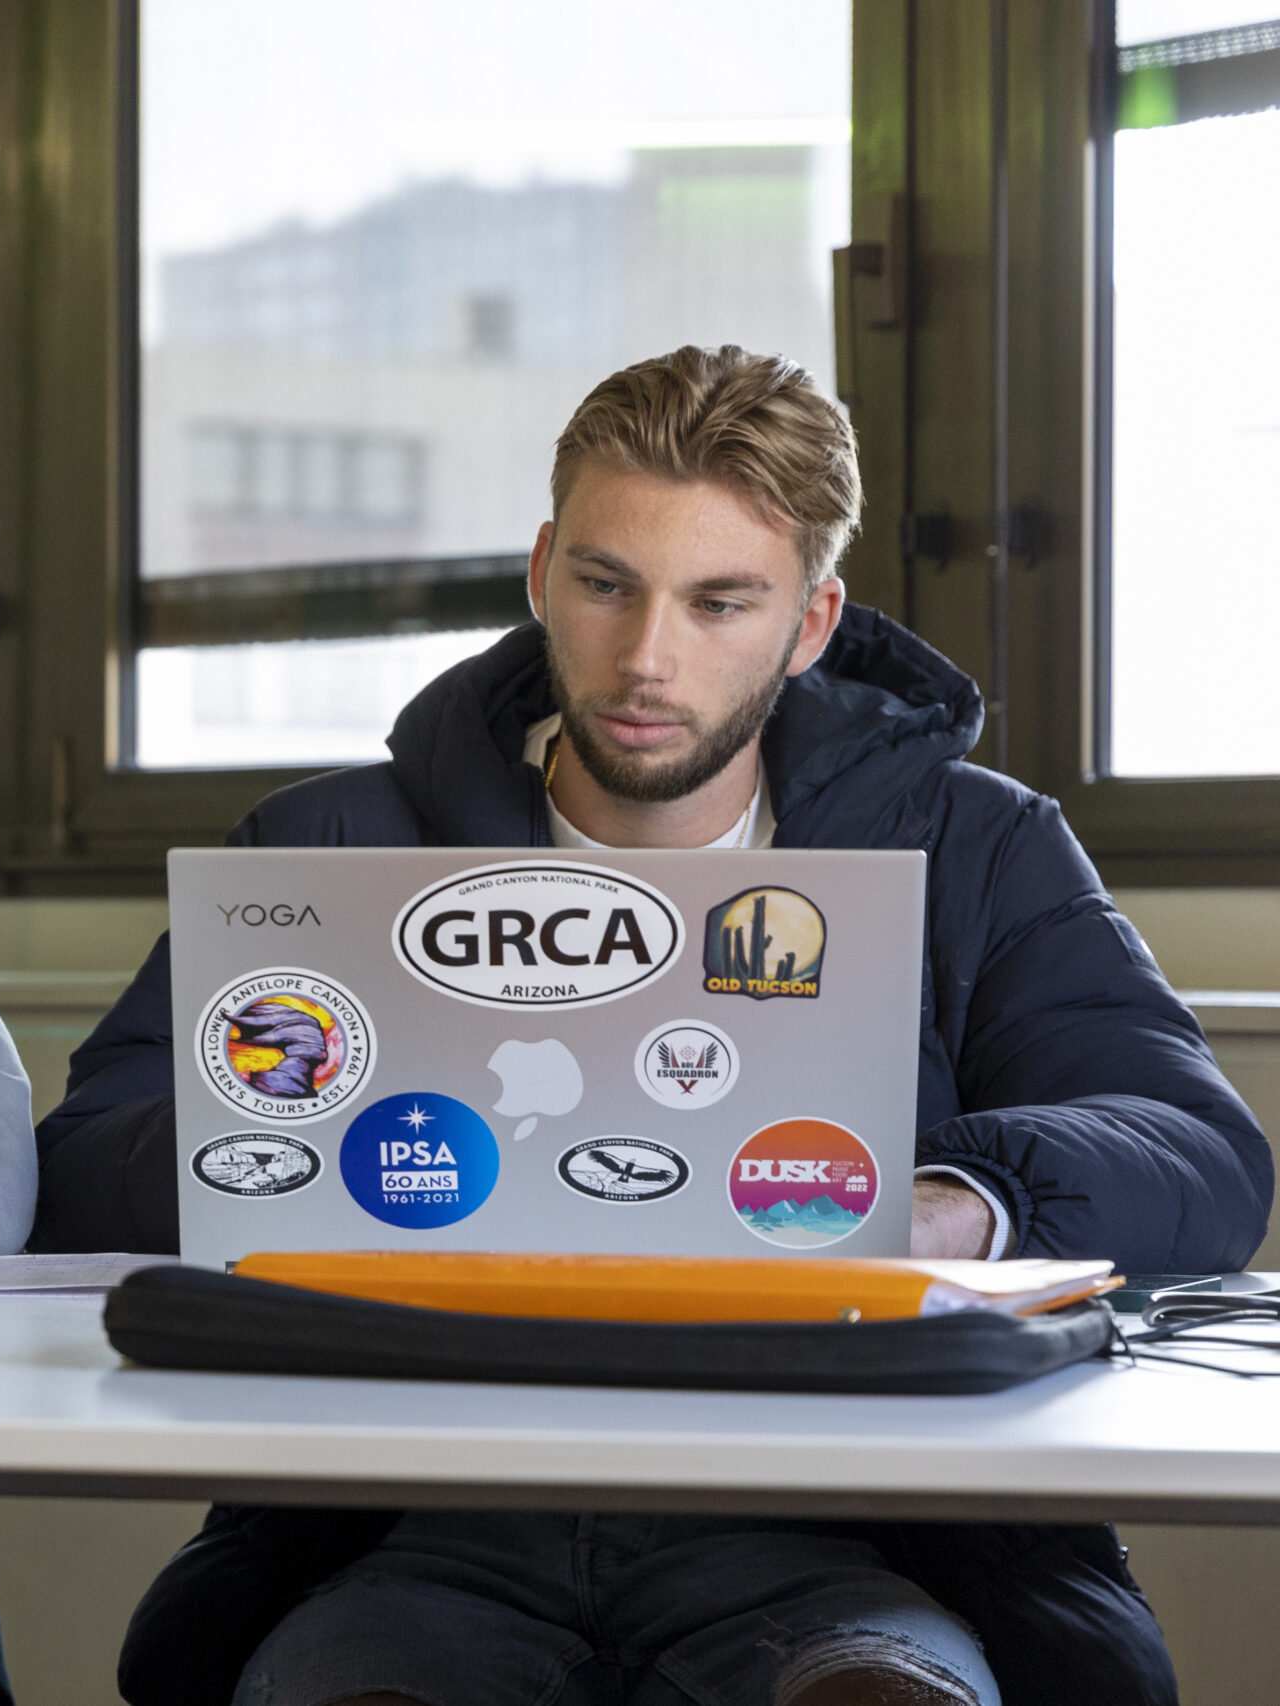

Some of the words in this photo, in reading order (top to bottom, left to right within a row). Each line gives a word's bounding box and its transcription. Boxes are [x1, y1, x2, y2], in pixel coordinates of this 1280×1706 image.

[458, 880, 494, 896] GRAND
[496, 875, 538, 886] CANYON
[541, 875, 592, 887] NATIONAL
[595, 881, 620, 895] PARK
[216, 903, 322, 927] YOGA
[421, 908, 653, 967] GRCA
[501, 984, 579, 998] ARIZONA
[707, 977, 741, 991] OLD
[747, 979, 818, 995] TUCSON
[208, 1007, 231, 1051] LOWER
[231, 978, 303, 1005] ANTELOPE
[311, 985, 360, 1032] CANYON
[321, 1084, 349, 1105] EST.
[347, 1046, 364, 1077] 1994
[657, 1069, 718, 1079] ESQUADRON
[212, 1065, 247, 1101] KEN'S
[252, 1098, 305, 1114] TOURS
[228, 1135, 255, 1144] CANYON
[256, 1134, 288, 1145] NATIONAL
[626, 1140, 659, 1151] NATIONAL
[379, 1141, 458, 1167] IPSA
[738, 1158, 831, 1184] DUSK
[385, 1174, 413, 1189] 60
[417, 1175, 452, 1188] ANS
[845, 1183, 868, 1192] 2022
[383, 1193, 460, 1204] 1961-2021
